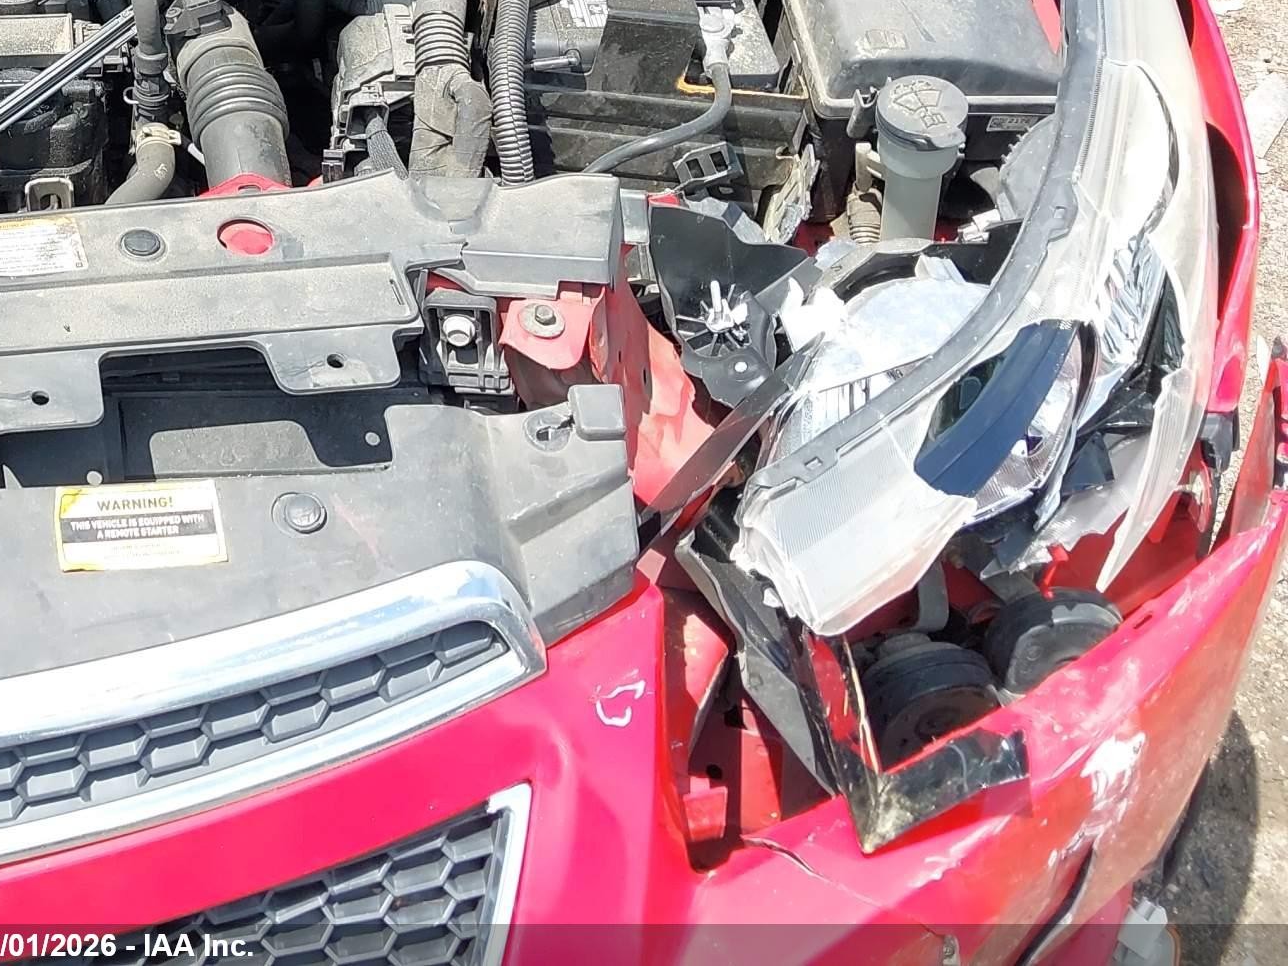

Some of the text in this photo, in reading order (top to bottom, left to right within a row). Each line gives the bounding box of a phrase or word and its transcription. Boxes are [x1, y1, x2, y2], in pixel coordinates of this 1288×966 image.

[97, 496, 173, 512] WARNING!
[70, 513, 205, 531] THIS VEHICLE IS EQUIPPED WITH
[97, 525, 180, 540] A REMOTE STARTER
